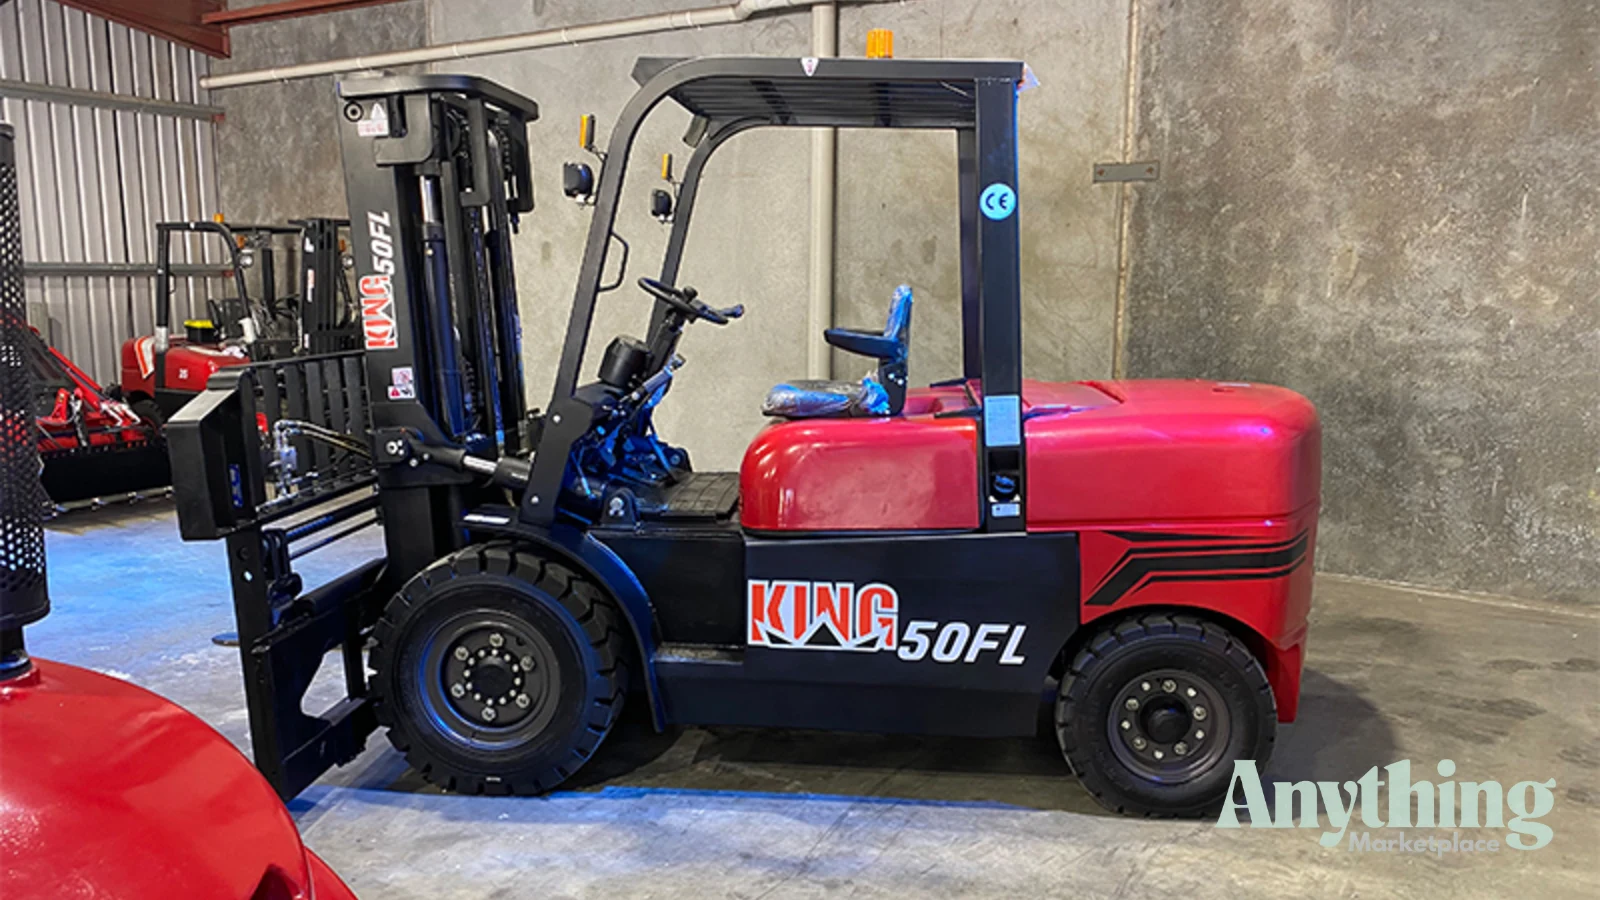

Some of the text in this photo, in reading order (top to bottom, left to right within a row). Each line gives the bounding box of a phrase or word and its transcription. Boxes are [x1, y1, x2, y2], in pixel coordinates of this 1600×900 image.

[985, 192, 1008, 210] CE
[359, 211, 398, 350] KING 50FL
[748, 579, 1027, 664] KING 50FL
